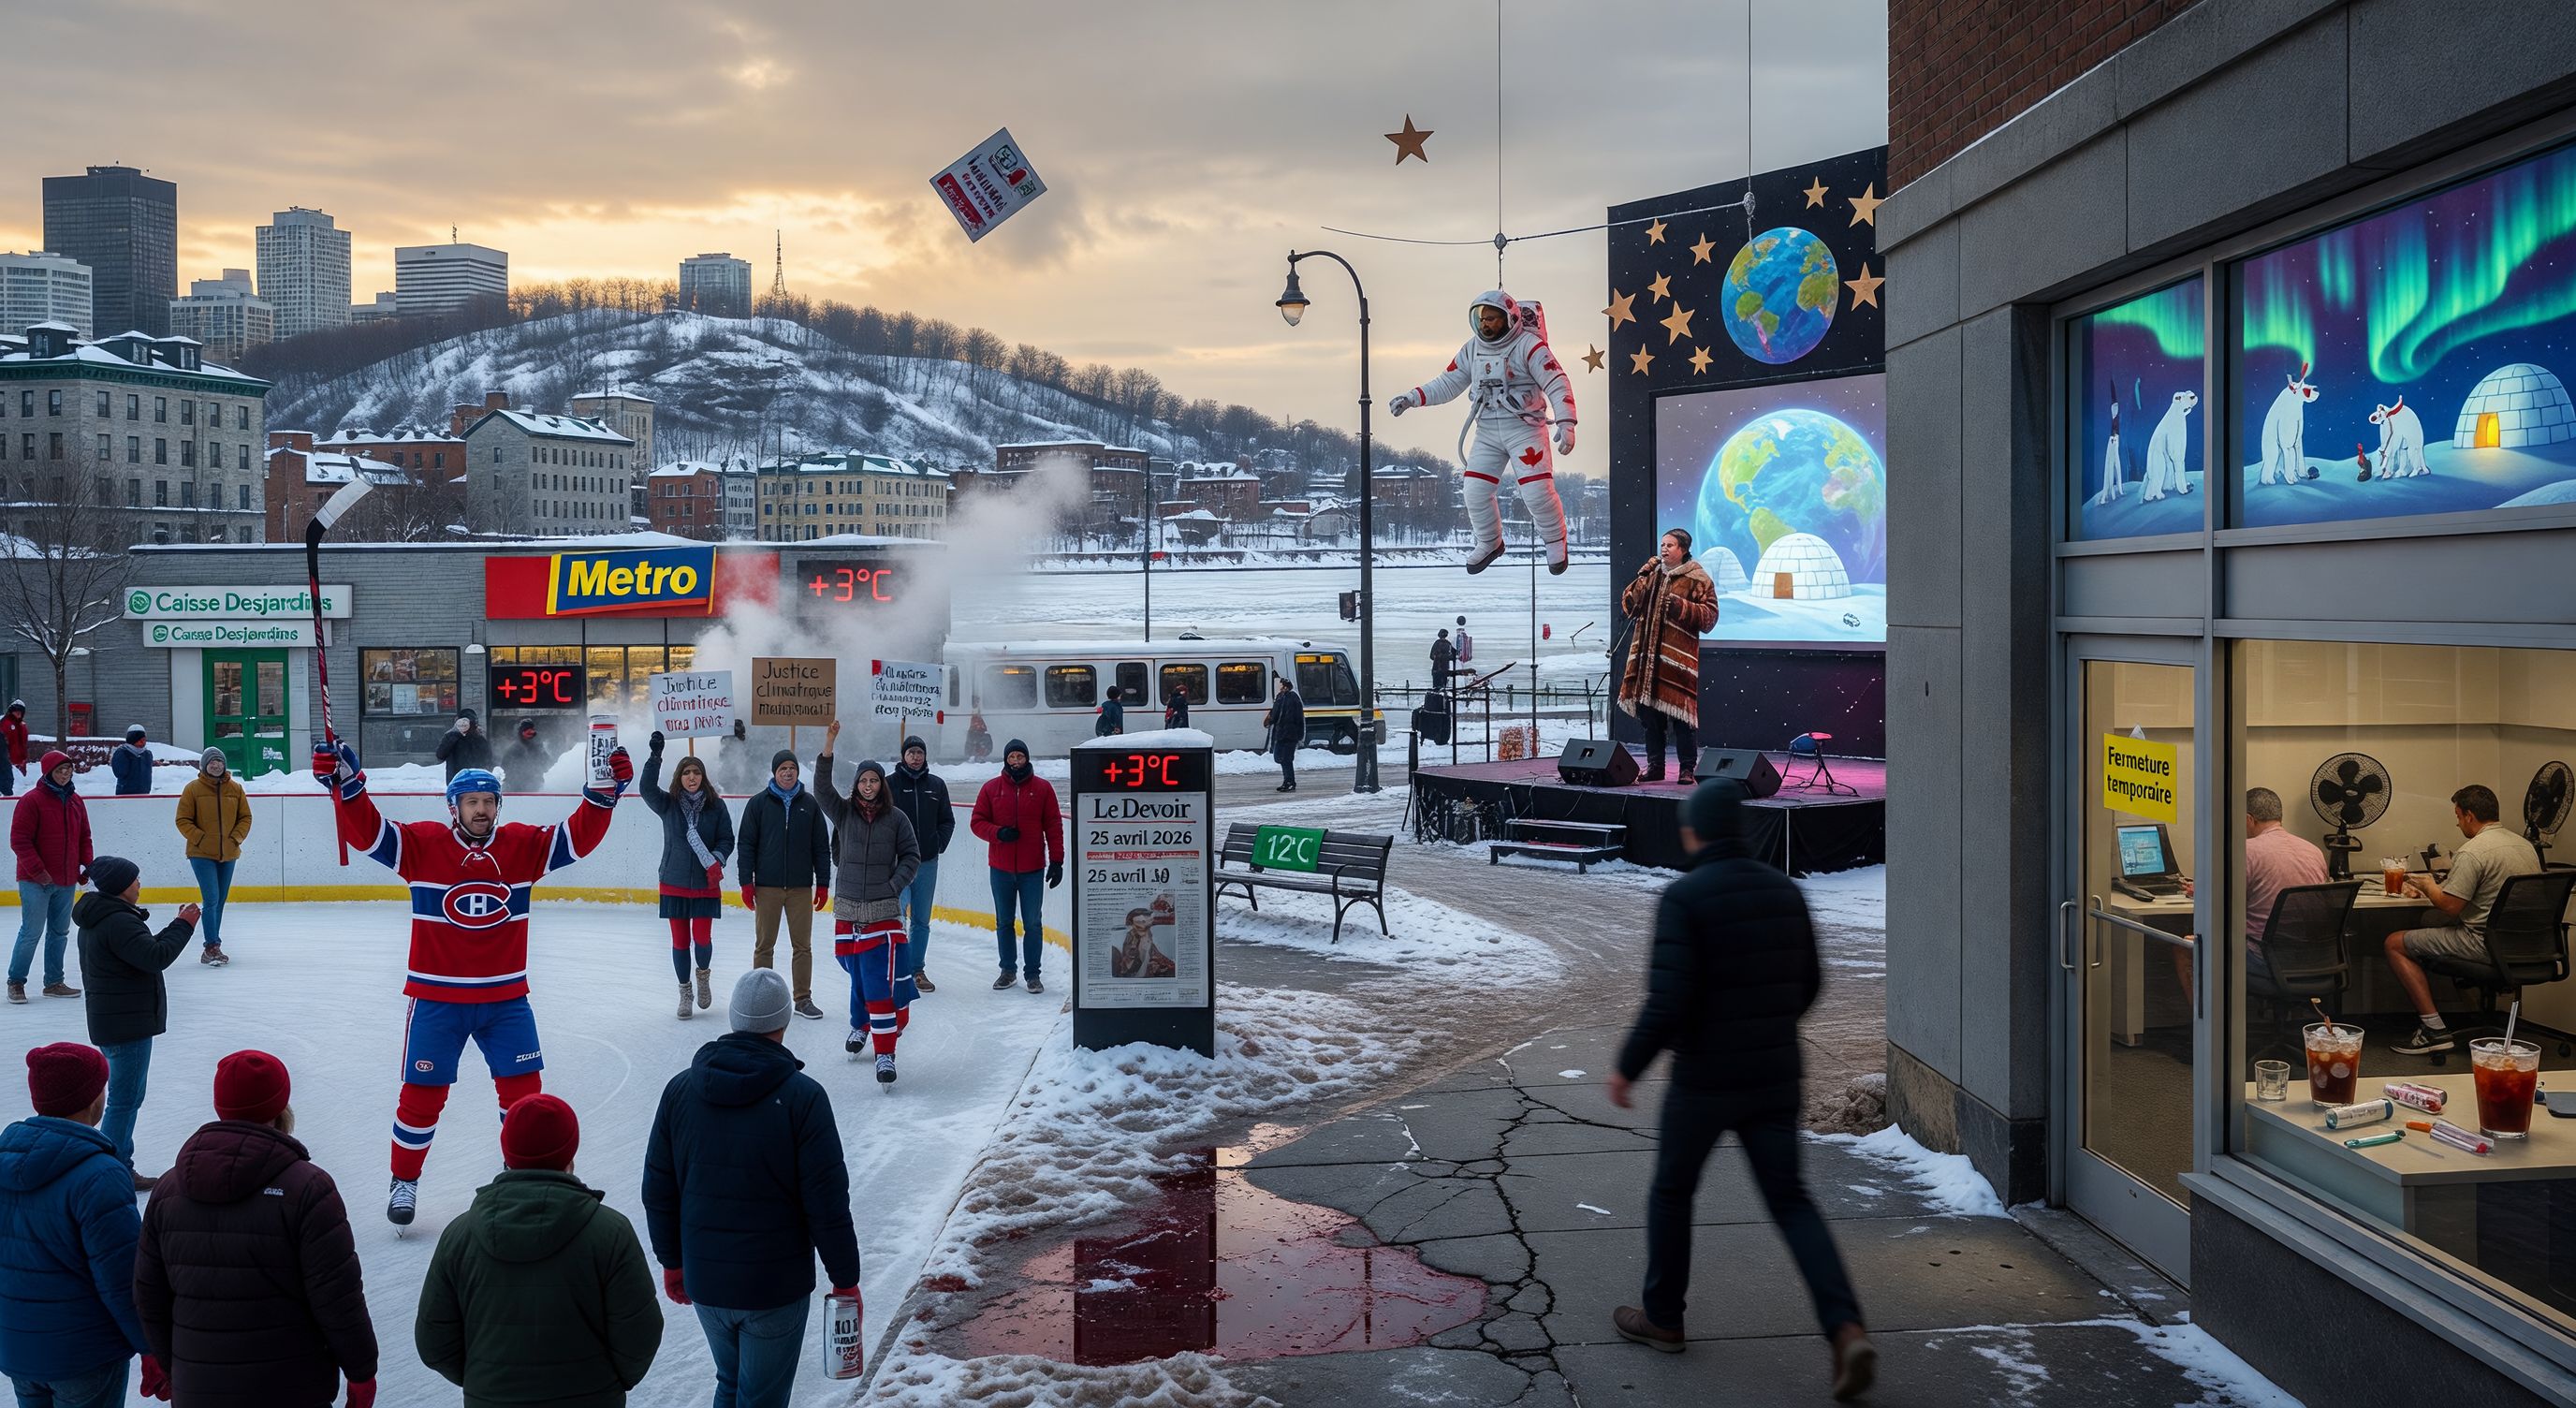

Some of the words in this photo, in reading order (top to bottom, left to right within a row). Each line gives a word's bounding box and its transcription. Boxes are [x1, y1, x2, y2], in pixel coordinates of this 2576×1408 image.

[567, 560, 697, 596] Metro
[808, 567, 892, 602] +3°C
[155, 592, 220, 611] Caisse
[225, 592, 332, 615] Desjardis
[762, 661, 820, 680] Justice
[497, 670, 572, 703] +3°C
[1104, 755, 1179, 786] +3°C
[2108, 745, 2170, 776] Fermeture
[2107, 774, 2172, 804] temporaire
[1094, 798, 1119, 818] Le
[1121, 798, 1192, 818] Devoir
[1090, 830, 1109, 845] 25
[1113, 829, 1149, 845] avril
[1152, 830, 1193, 845] 2026
[1088, 869, 1107, 883] 25
[1111, 867, 1146, 883] avril
